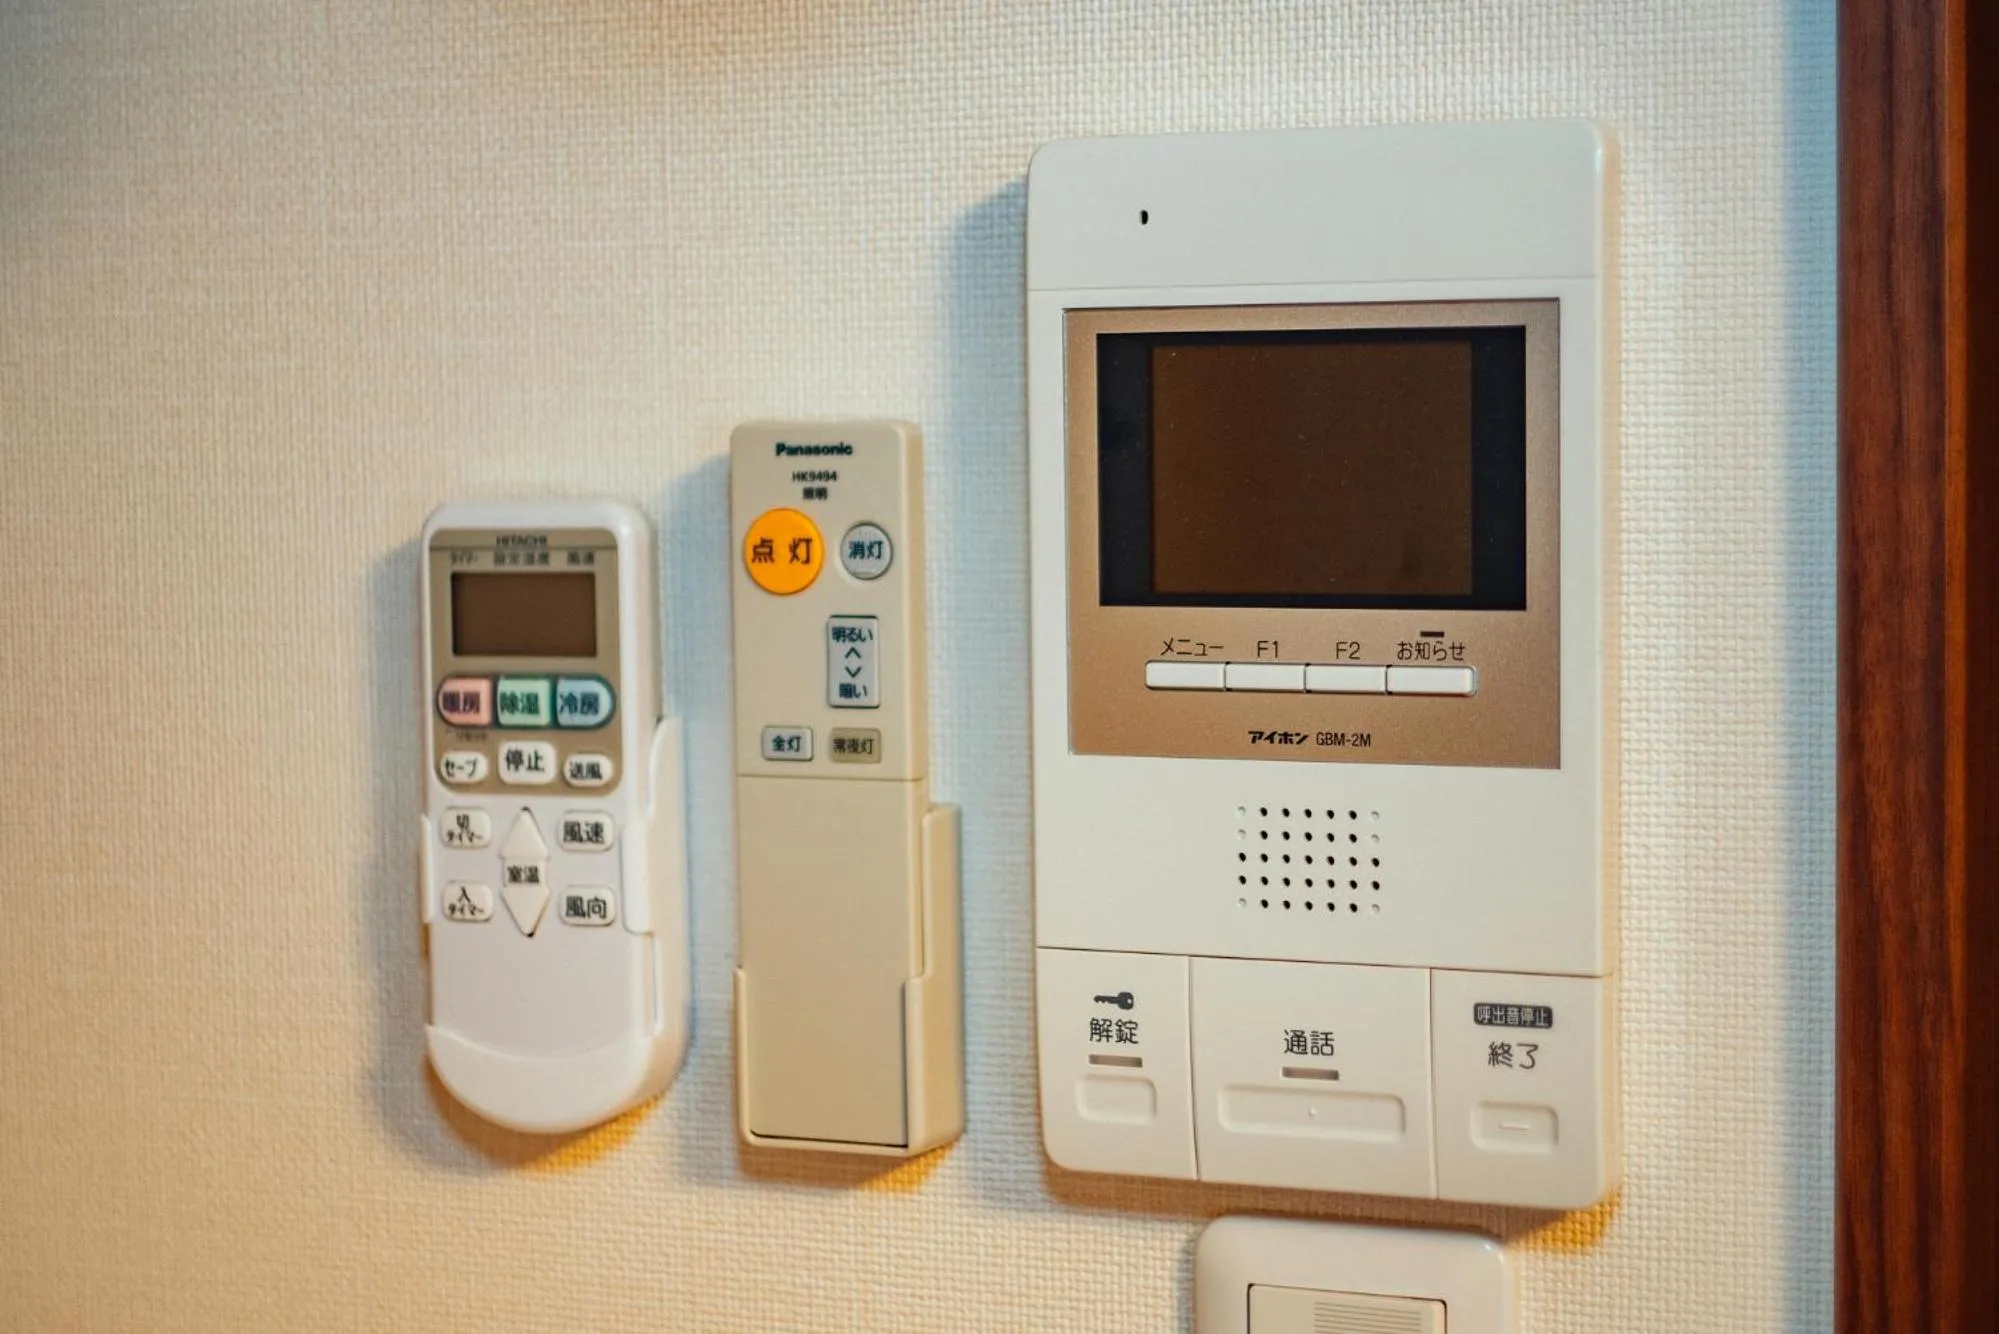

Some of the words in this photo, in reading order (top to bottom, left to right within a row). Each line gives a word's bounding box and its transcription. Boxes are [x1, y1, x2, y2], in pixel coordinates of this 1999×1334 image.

[775, 442, 853, 456] Panasonic
[792, 470, 838, 482] HK9494
[751, 537, 813, 564] 点灯
[848, 540, 884, 560] 消灯
[832, 627, 874, 643] 明るい
[1161, 637, 1224, 657] メニュー
[1257, 641, 1280, 659] F1
[1336, 642, 1361, 660] F2
[1397, 640, 1467, 662] お知らせ
[839, 683, 867, 699] 暗い
[442, 691, 481, 713] 暖房
[559, 691, 600, 716] 冷房
[772, 735, 802, 752] 全灯
[1248, 731, 1309, 745] アイホン
[1316, 732, 1371, 747] GBM-2M
[505, 749, 545, 773] 停止
[569, 761, 603, 780] 送風
[563, 821, 605, 844] 風速
[507, 864, 540, 884] 室温
[457, 886, 472, 903] 入
[447, 902, 485, 916] タイマー
[565, 895, 608, 919] 風向
[1477, 1005, 1550, 1027] 呼出音停止
[1089, 1017, 1139, 1045] 解錠
[1283, 1029, 1336, 1057] 通話
[1488, 1041, 1539, 1069] 終了
